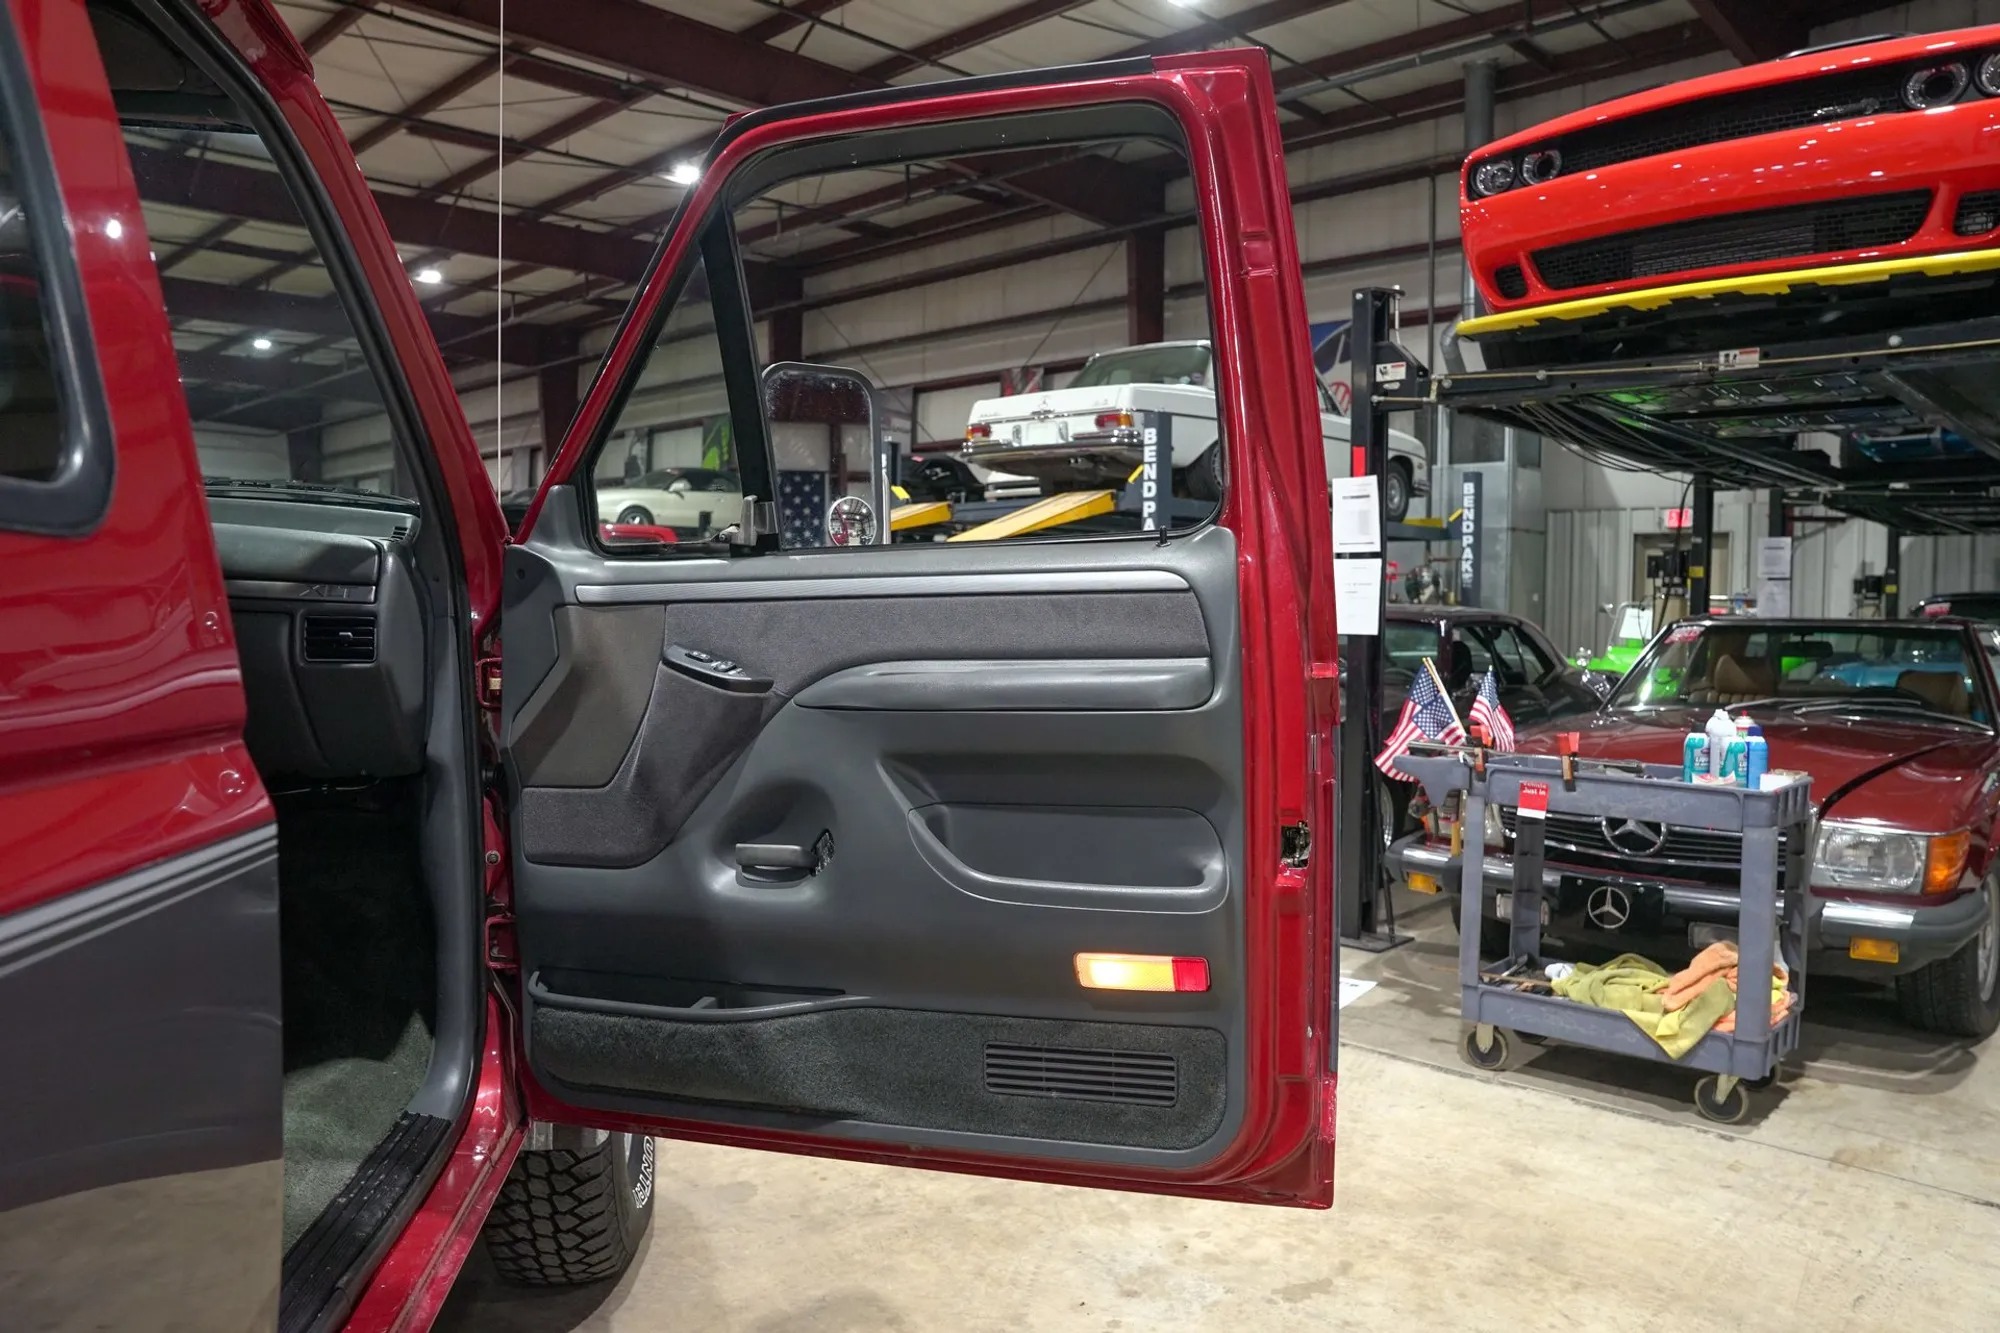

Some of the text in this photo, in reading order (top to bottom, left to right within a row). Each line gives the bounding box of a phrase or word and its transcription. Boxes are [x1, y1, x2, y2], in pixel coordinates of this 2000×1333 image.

[1142, 427, 1158, 531] BENDPA
[1461, 482, 1475, 572] BENDPAK
[299, 584, 358, 598] XLT
